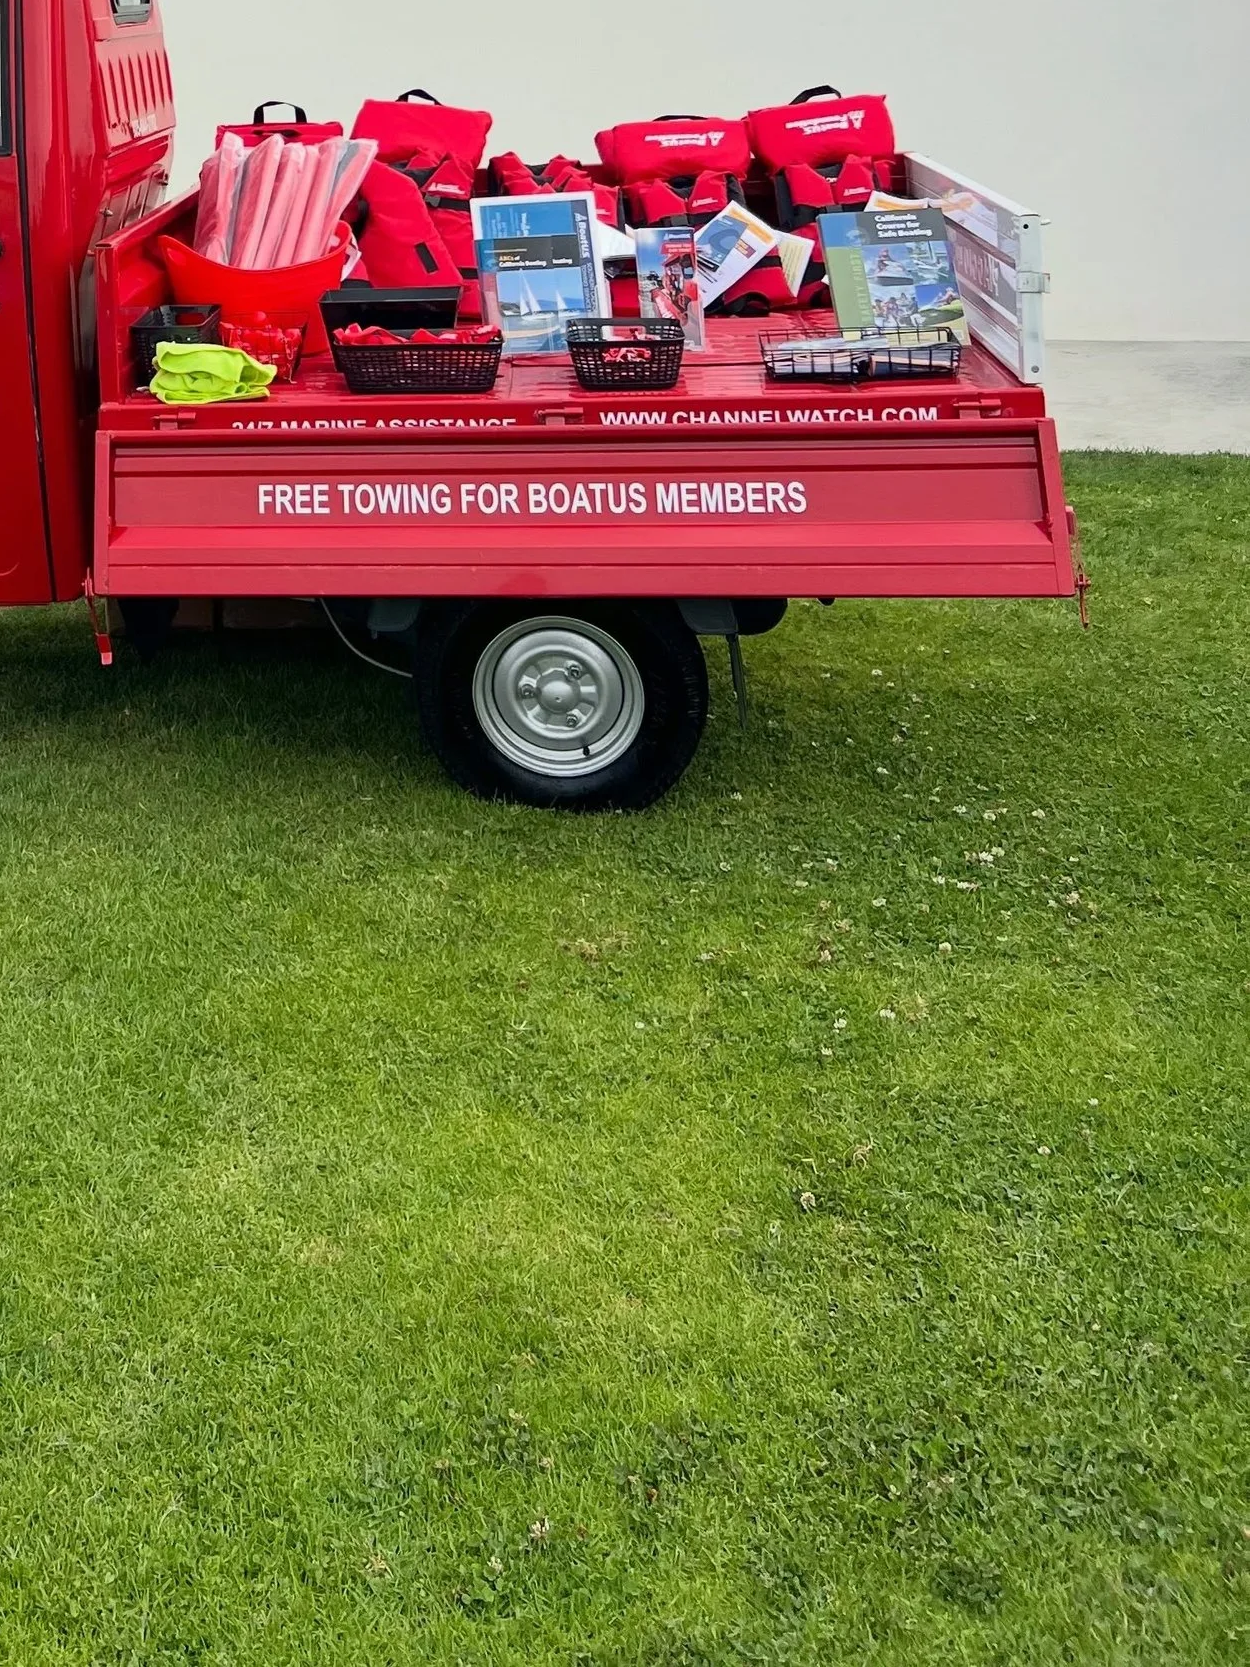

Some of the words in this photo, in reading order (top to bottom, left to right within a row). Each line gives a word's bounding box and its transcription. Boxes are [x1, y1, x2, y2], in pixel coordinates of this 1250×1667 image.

[875, 214, 917, 222] California
[876, 222, 906, 230] Course
[907, 221, 920, 229] for
[878, 230, 897, 238] Safe
[898, 229, 933, 238] Boating
[578, 222, 590, 259] BoatUS
[258, 483, 330, 515] FREE
[337, 483, 452, 515] TOWING
[460, 482, 520, 515] FOR
[527, 482, 647, 514] BOATUS
[656, 481, 807, 514] MEMBERS
